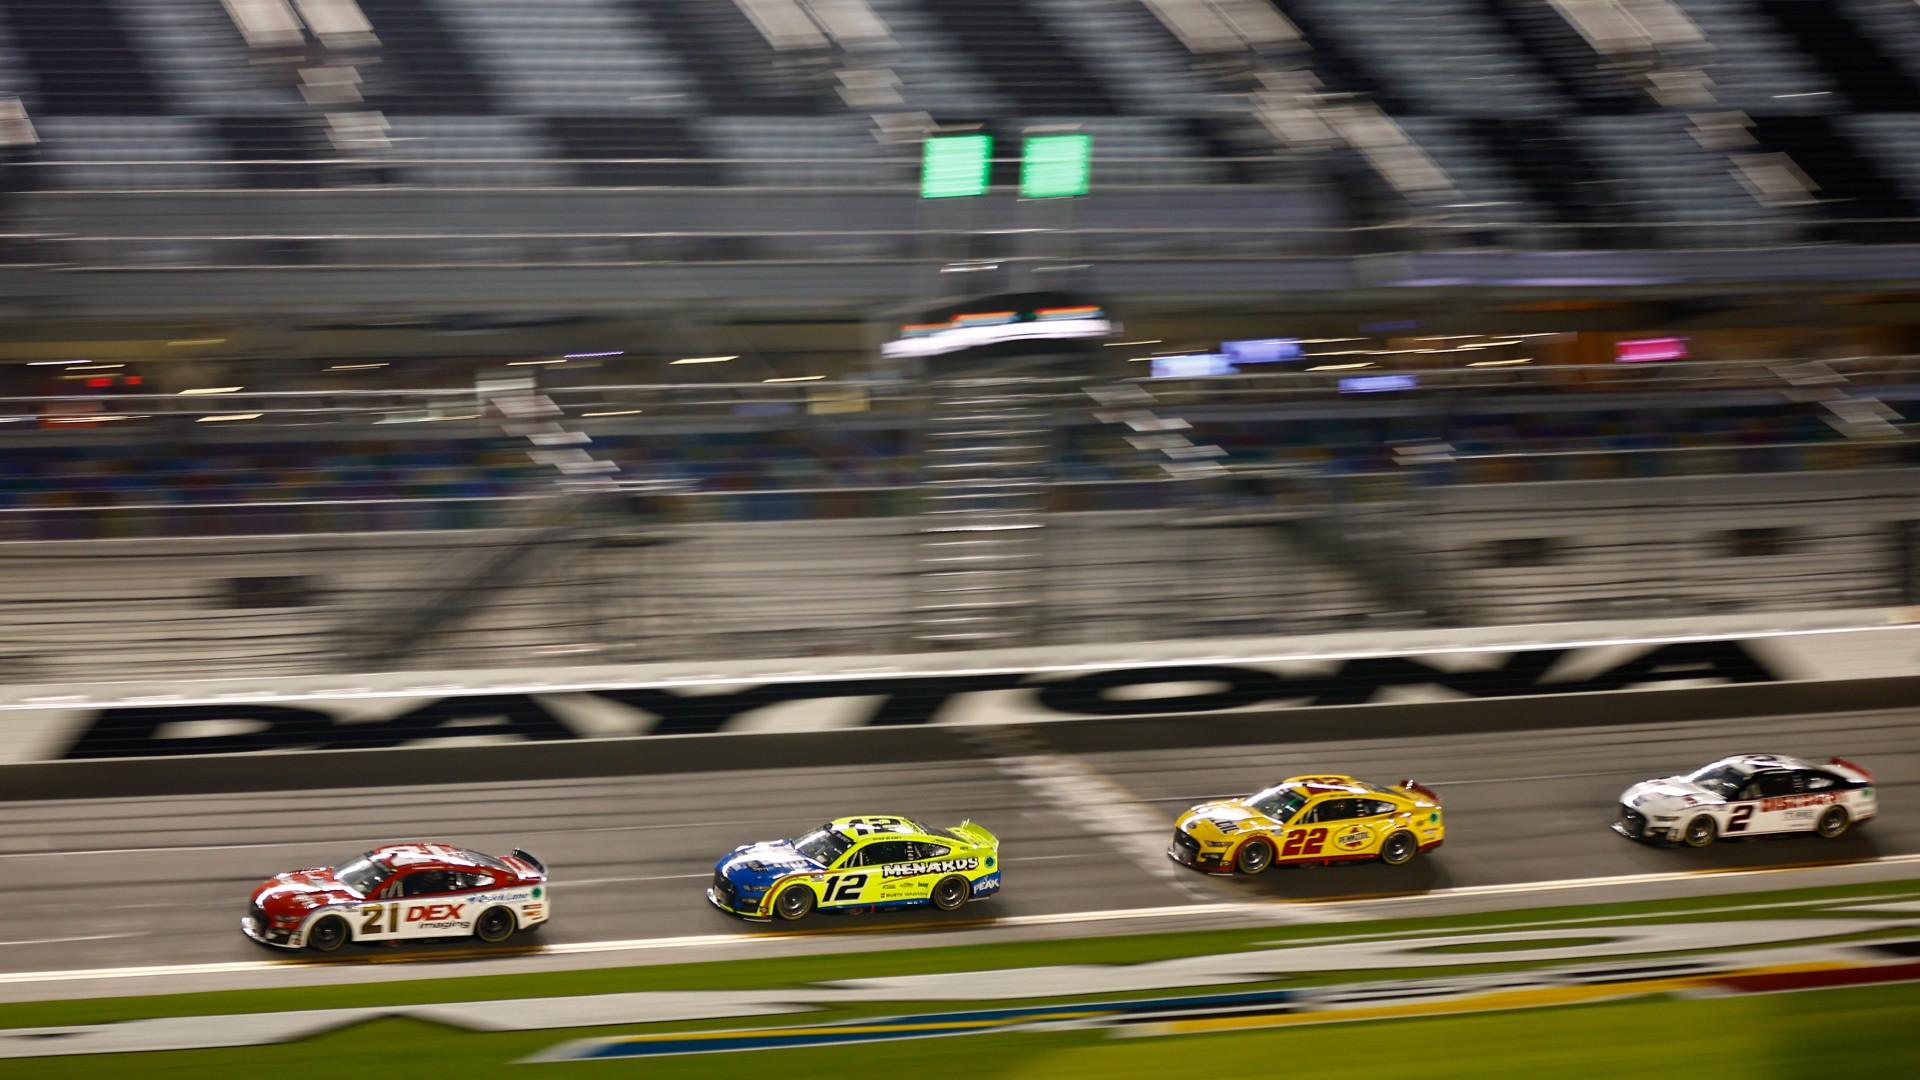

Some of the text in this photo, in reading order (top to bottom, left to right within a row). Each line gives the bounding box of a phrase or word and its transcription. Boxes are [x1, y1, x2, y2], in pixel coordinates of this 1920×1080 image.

[60, 640, 1780, 758] DAYTONA
[1727, 804, 1755, 832] 2
[1281, 827, 1328, 857] 22
[882, 857, 979, 878] MENARDS
[822, 873, 868, 903] 12
[973, 876, 1000, 895] PEAK
[361, 903, 400, 935] 21
[405, 903, 465, 922] DEX
[419, 921, 471, 929] imaging
